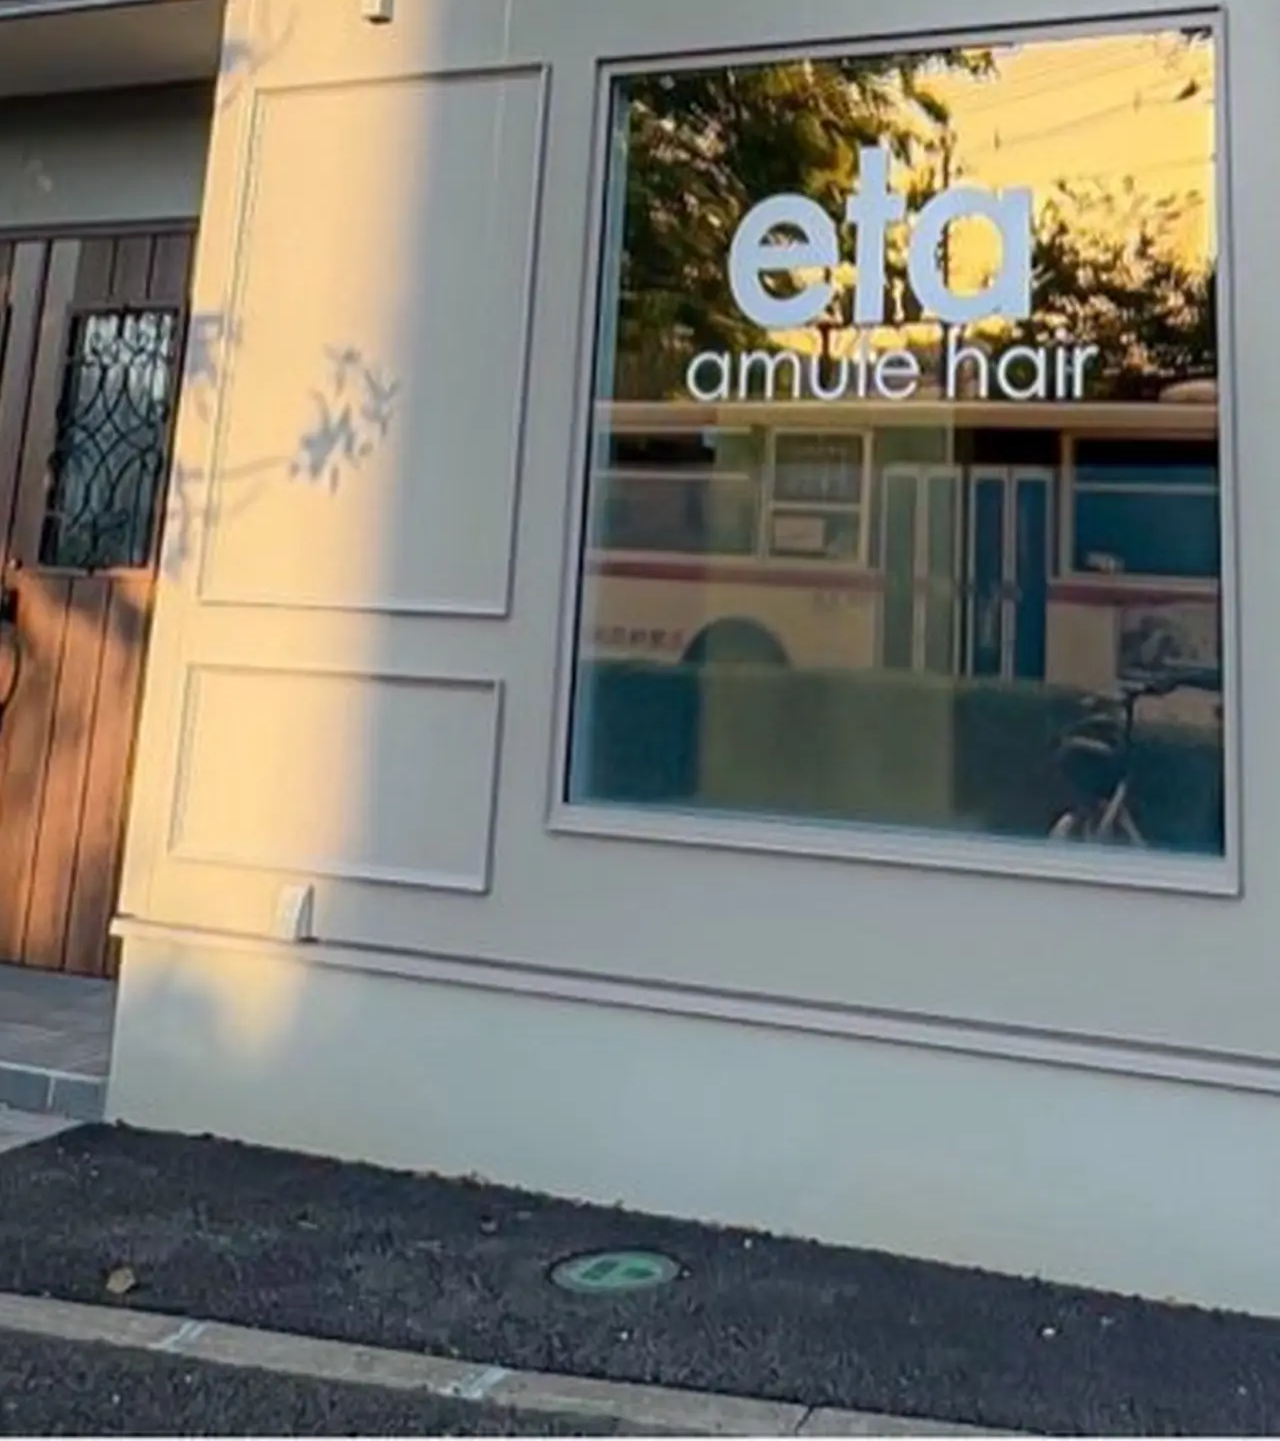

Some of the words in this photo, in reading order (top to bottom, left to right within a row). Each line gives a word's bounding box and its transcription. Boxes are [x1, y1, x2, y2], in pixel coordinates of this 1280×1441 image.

[728, 145, 1035, 331] eta
[686, 332, 920, 402] amule
[945, 327, 1098, 401] hair
